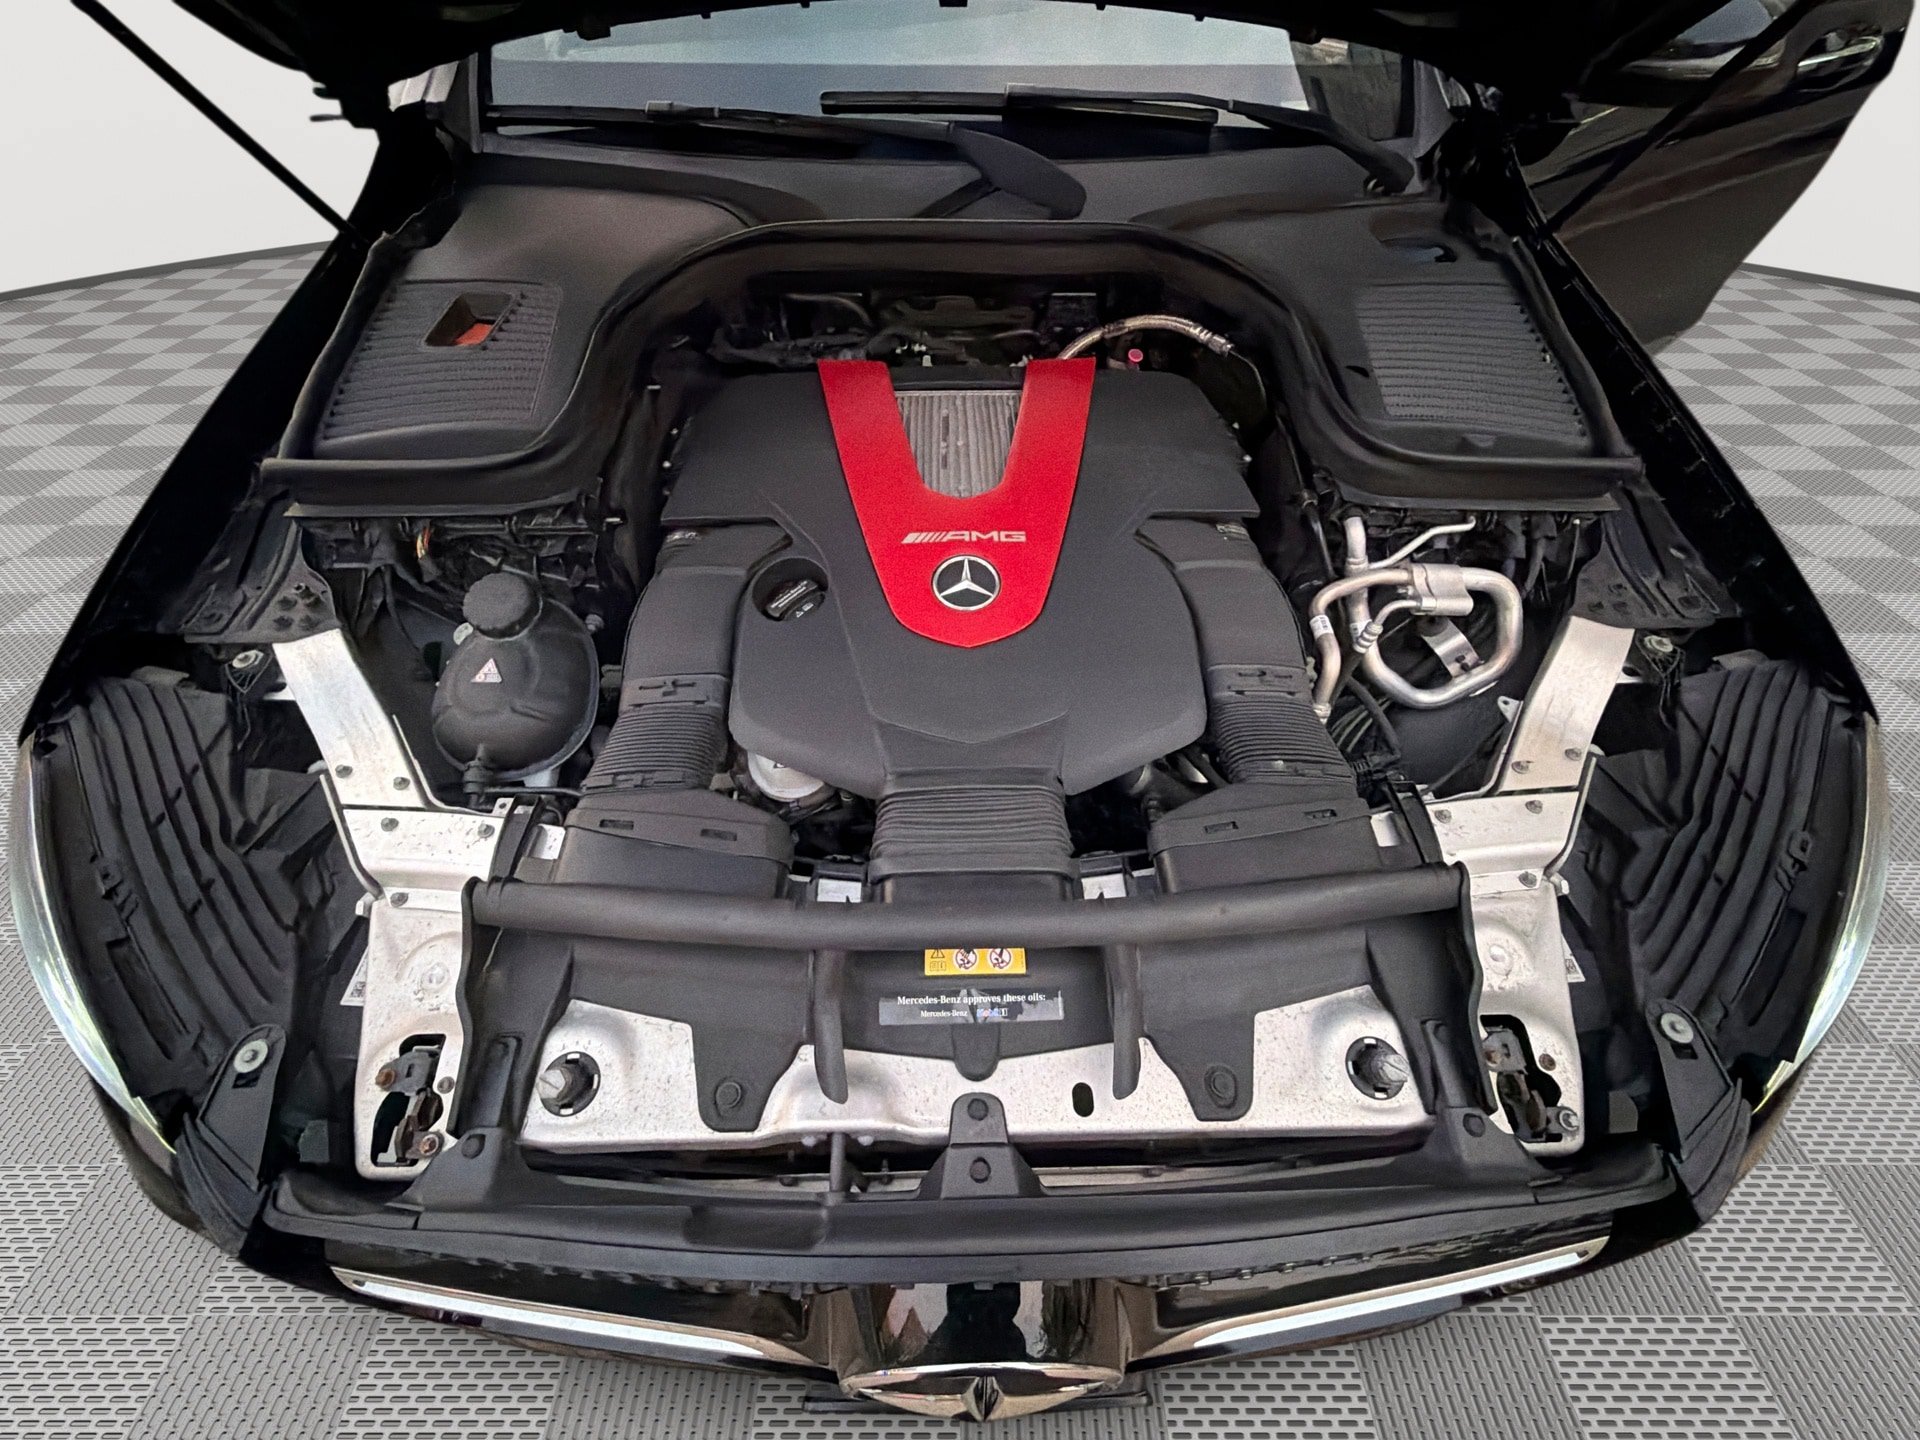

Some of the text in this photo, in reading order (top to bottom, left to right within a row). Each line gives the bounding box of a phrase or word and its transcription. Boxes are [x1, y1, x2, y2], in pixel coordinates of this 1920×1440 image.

[946, 530, 1026, 543] AMG
[897, 995, 961, 1005] Mercedes-Benz
[963, 995, 1001, 1006] approves
[1003, 993, 1026, 1002] these
[920, 1009, 968, 1018] Mercedes-Benz
